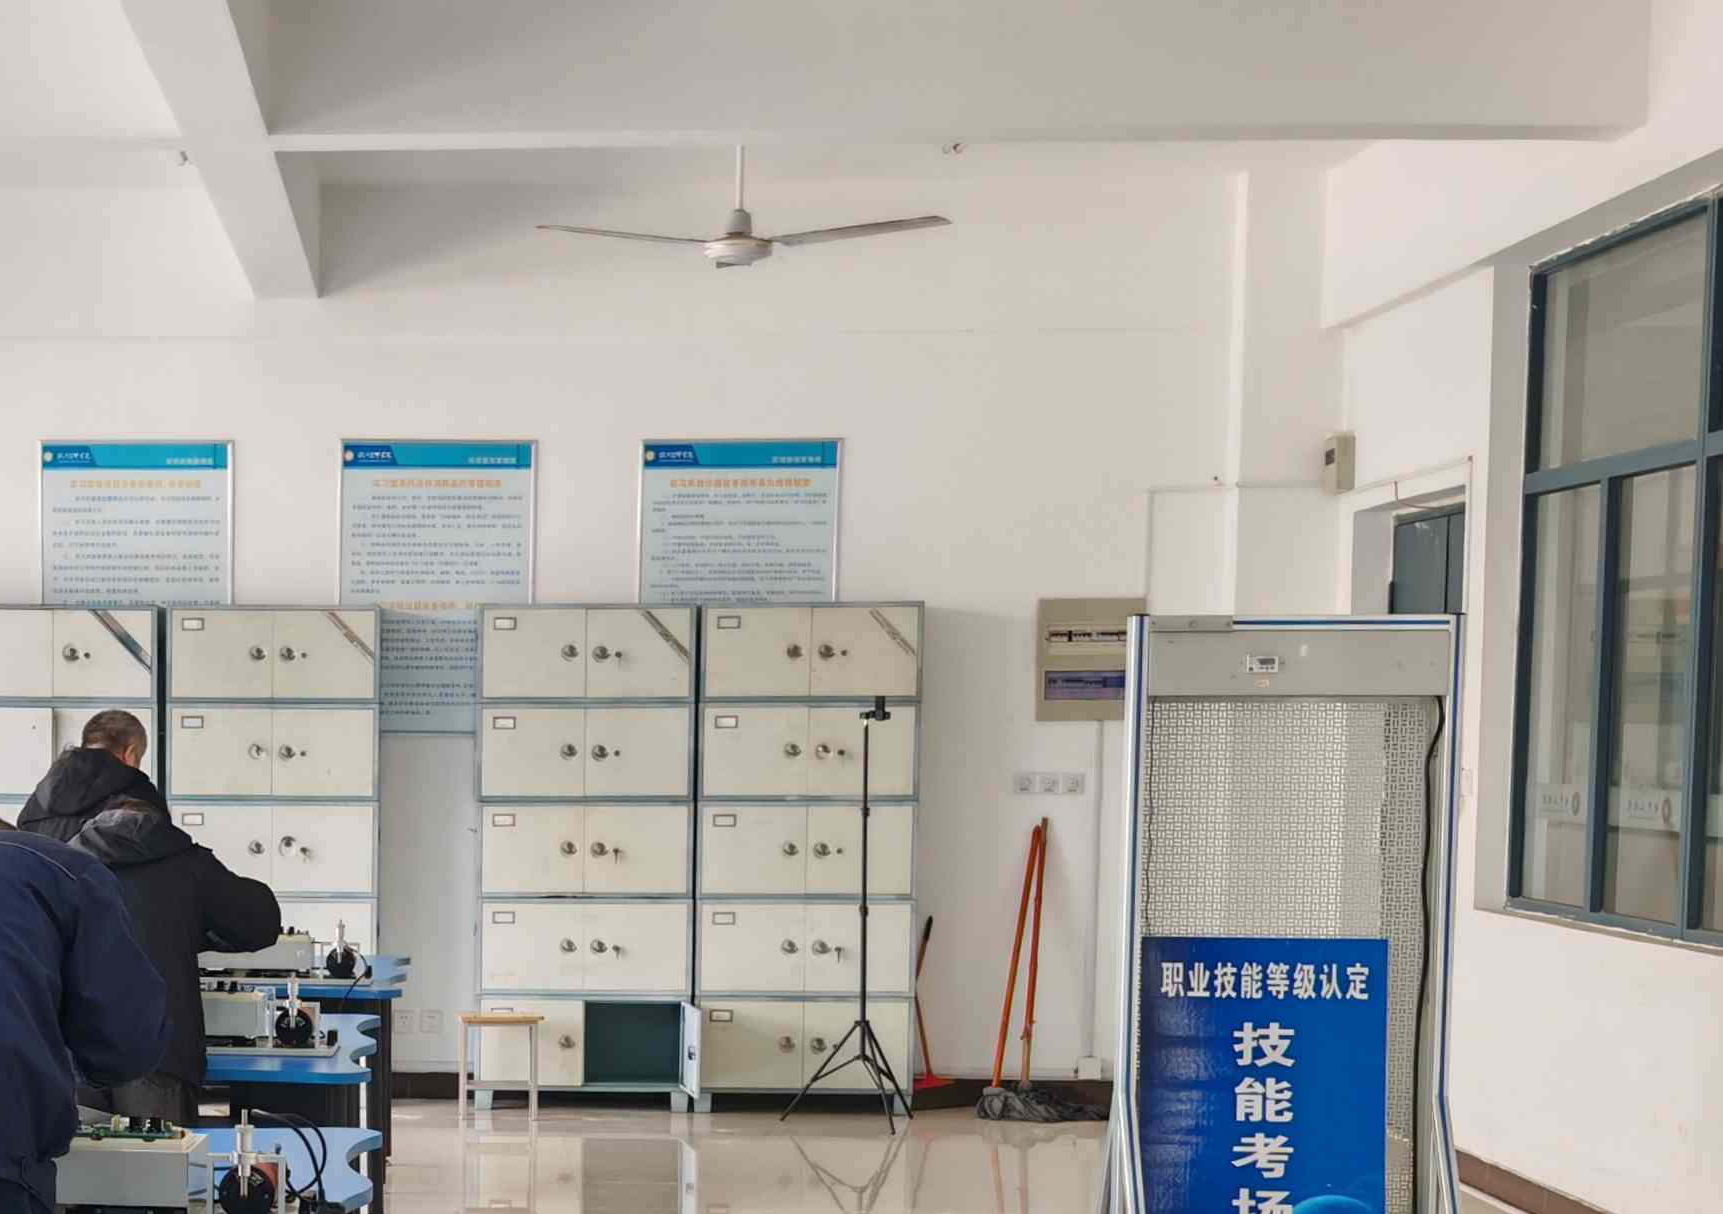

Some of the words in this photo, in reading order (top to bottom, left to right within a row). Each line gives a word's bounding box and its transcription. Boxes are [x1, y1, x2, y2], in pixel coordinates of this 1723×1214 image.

[1160, 961, 1370, 1000] 职业技能等级认定
